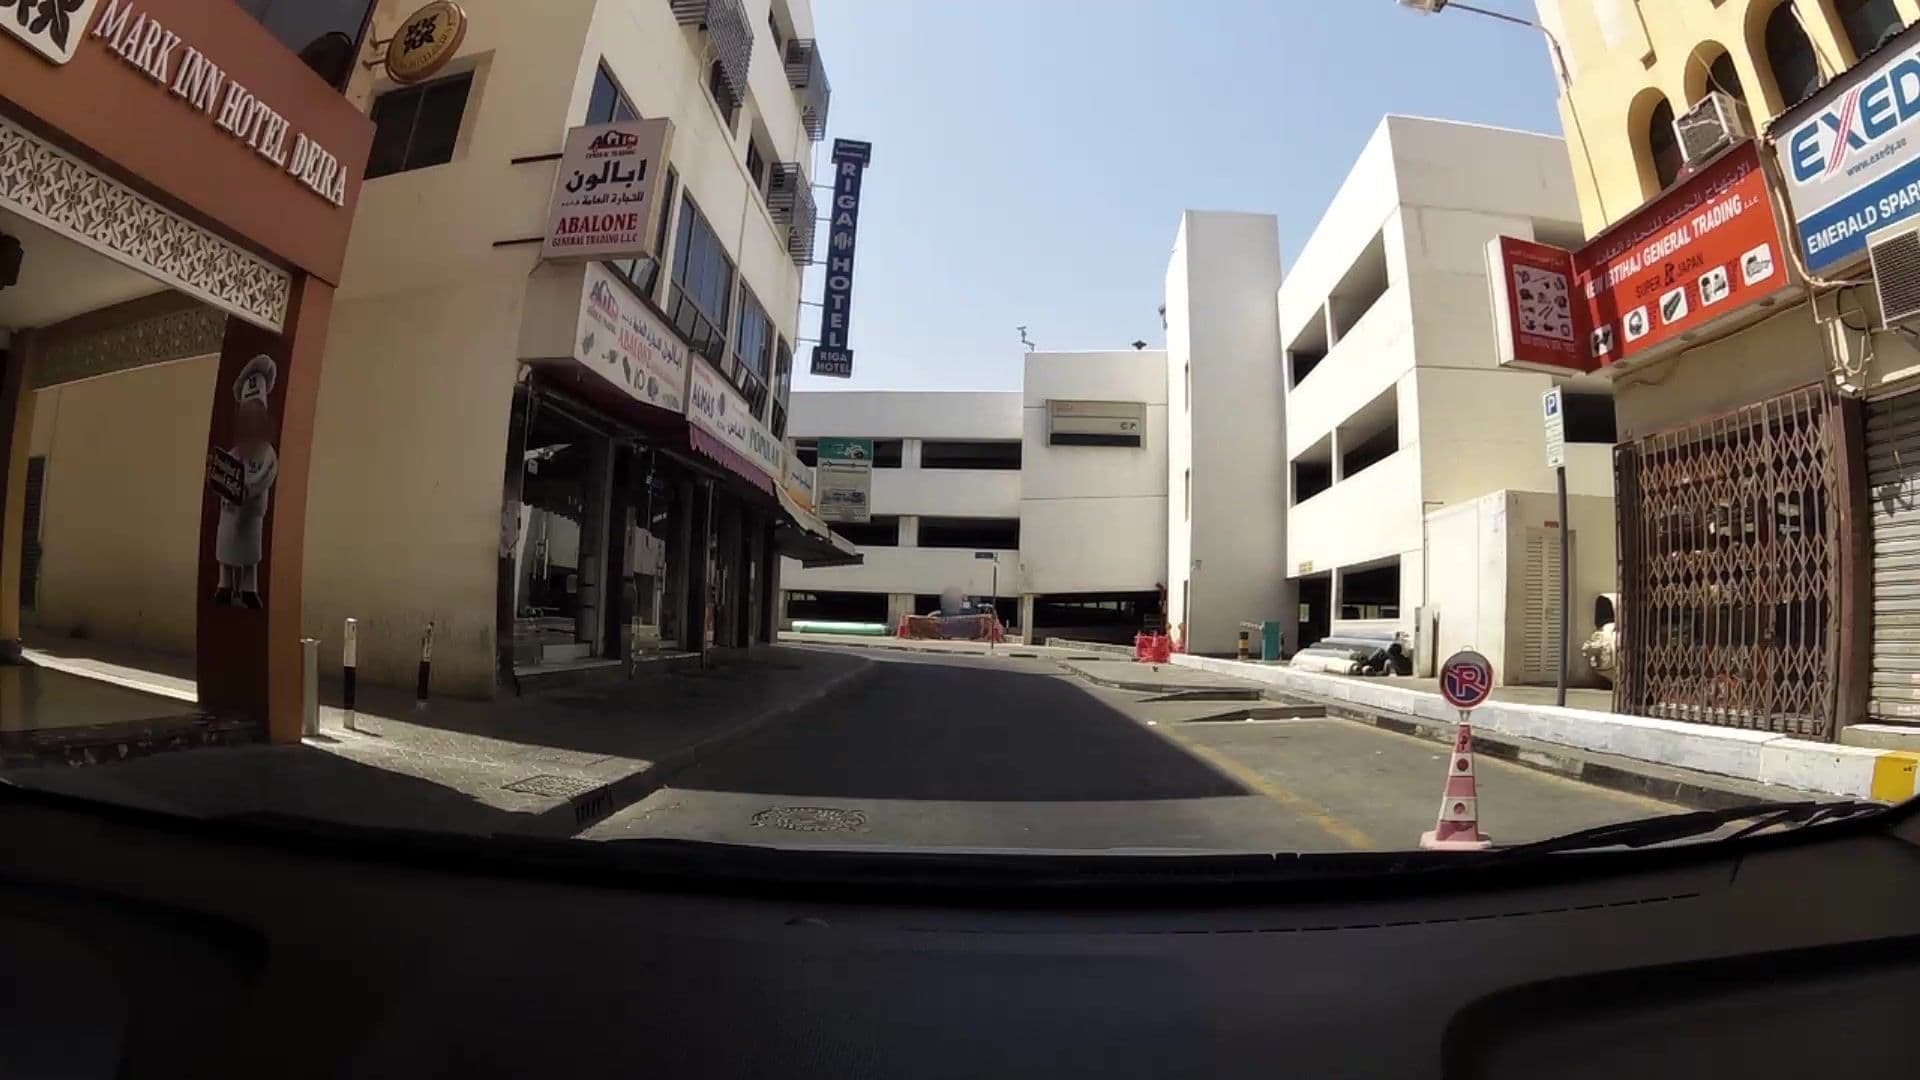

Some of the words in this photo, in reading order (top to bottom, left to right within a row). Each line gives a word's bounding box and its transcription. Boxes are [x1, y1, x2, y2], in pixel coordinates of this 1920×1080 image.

[91, 0, 181, 85] MARK
[168, 45, 227, 115] INN
[214, 80, 290, 167] HOTEL
[286, 132, 347, 206] DEIRA
[566, 159, 648, 194] ابالون
[835, 161, 858, 227] RIGA
[555, 212, 638, 236] ABALONE
[1643, 224, 1692, 266] GENERAL
[1692, 194, 1743, 239] TRADING
[1807, 206, 1878, 255] EMERALD
[1879, 178, 1920, 219] SPAR
[551, 234, 585, 248] GENERAL
[585, 232, 620, 246] TRADING
[1635, 274, 1663, 299] SUPER
[1677, 253, 1705, 278] JAPAN
[828, 256, 851, 348] HOTEL
[815, 361, 850, 374] HOTEL
[820, 351, 848, 362] RIGA
